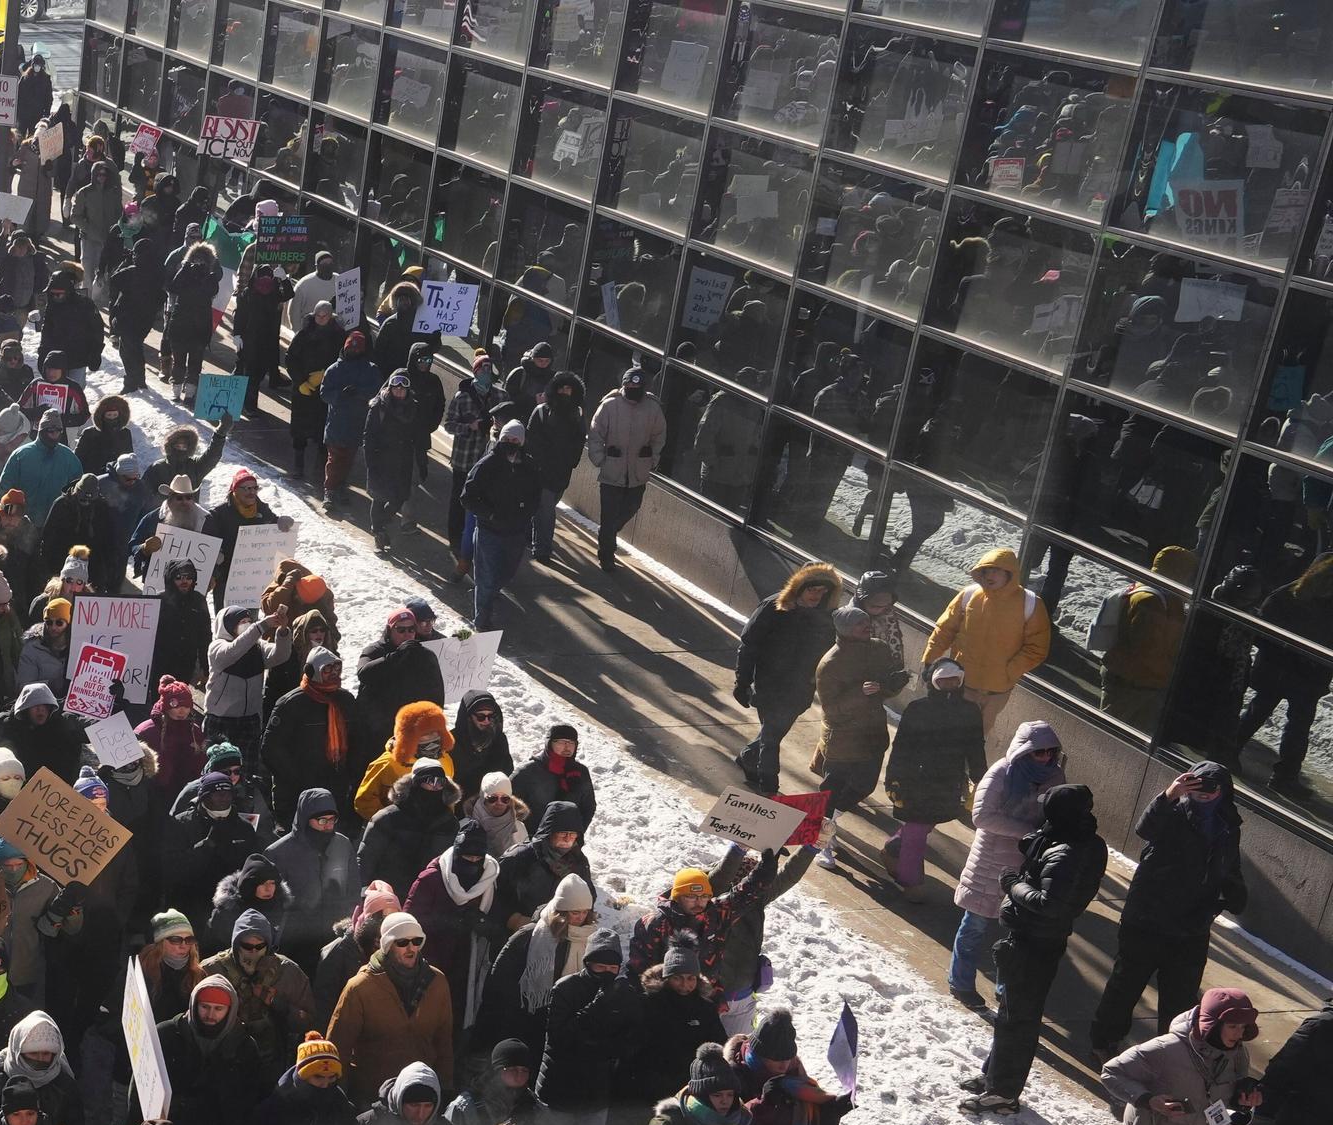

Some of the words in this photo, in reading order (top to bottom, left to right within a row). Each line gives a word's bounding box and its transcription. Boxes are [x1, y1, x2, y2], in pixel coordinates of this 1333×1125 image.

[206, 116, 259, 137] RESIST
[200, 138, 234, 157] ICE
[234, 146, 254, 158] NOW
[236, 137, 254, 149] OUT
[257, 252, 306, 262] NUMBERS
[427, 285, 461, 310] This
[436, 311, 457, 321] HAS
[438, 322, 457, 332] STOP
[31, 778, 78, 818] MORE
[79, 811, 120, 850] PUGS
[724, 793, 777, 819] Families
[30, 804, 69, 835] LESS
[71, 831, 105, 866] ICE
[709, 816, 756, 840] Together
[15, 819, 89, 878] THUGS
